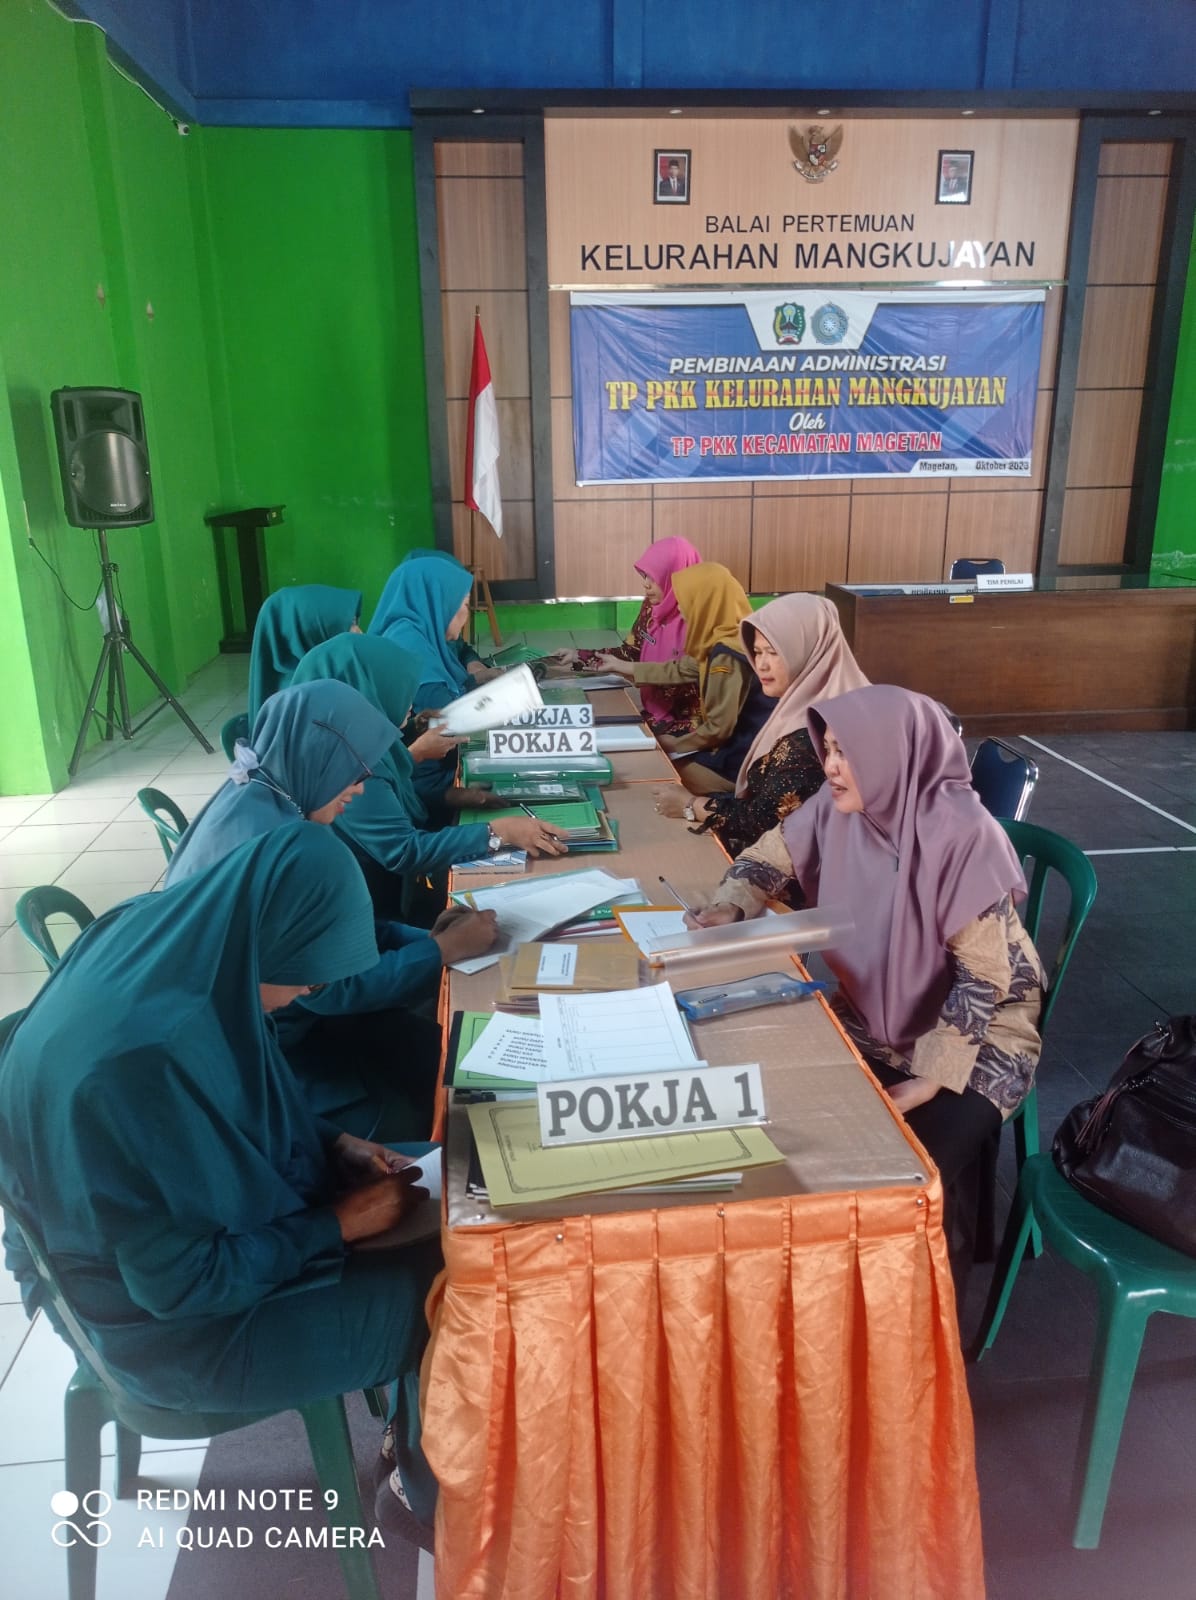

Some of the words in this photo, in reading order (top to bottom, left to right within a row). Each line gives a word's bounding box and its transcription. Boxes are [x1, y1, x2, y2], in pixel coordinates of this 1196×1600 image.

[706, 215, 770, 233] BALAI
[783, 214, 914, 233] PERTEMUAN
[581, 243, 779, 271] KELURAHAN
[796, 242, 1034, 268] MANGKUJAYAN
[669, 357, 797, 374] PEMBINAAN
[799, 355, 946, 372] ADMINISTRASI
[606, 381, 639, 410] TP
[646, 381, 697, 409] PKK
[705, 379, 841, 407] KELURAHAN
[848, 377, 1006, 408] MANGKUJAYAN
[789, 412, 825, 431] Oleh
[672, 437, 695, 457] TP
[701, 436, 737, 456] PKK
[743, 433, 850, 455] KECAMATAN
[856, 432, 942, 452] MAGETAN
[920, 461, 958, 472] Magetan,
[975, 461, 1006, 470] Oktober
[504, 707, 573, 726] OKJA
[579, 707, 591, 725] 3
[493, 732, 573, 754] POKJA
[579, 731, 593, 752] 2
[546, 1076, 717, 1137] POKJA
[734, 1072, 758, 1118] 1
